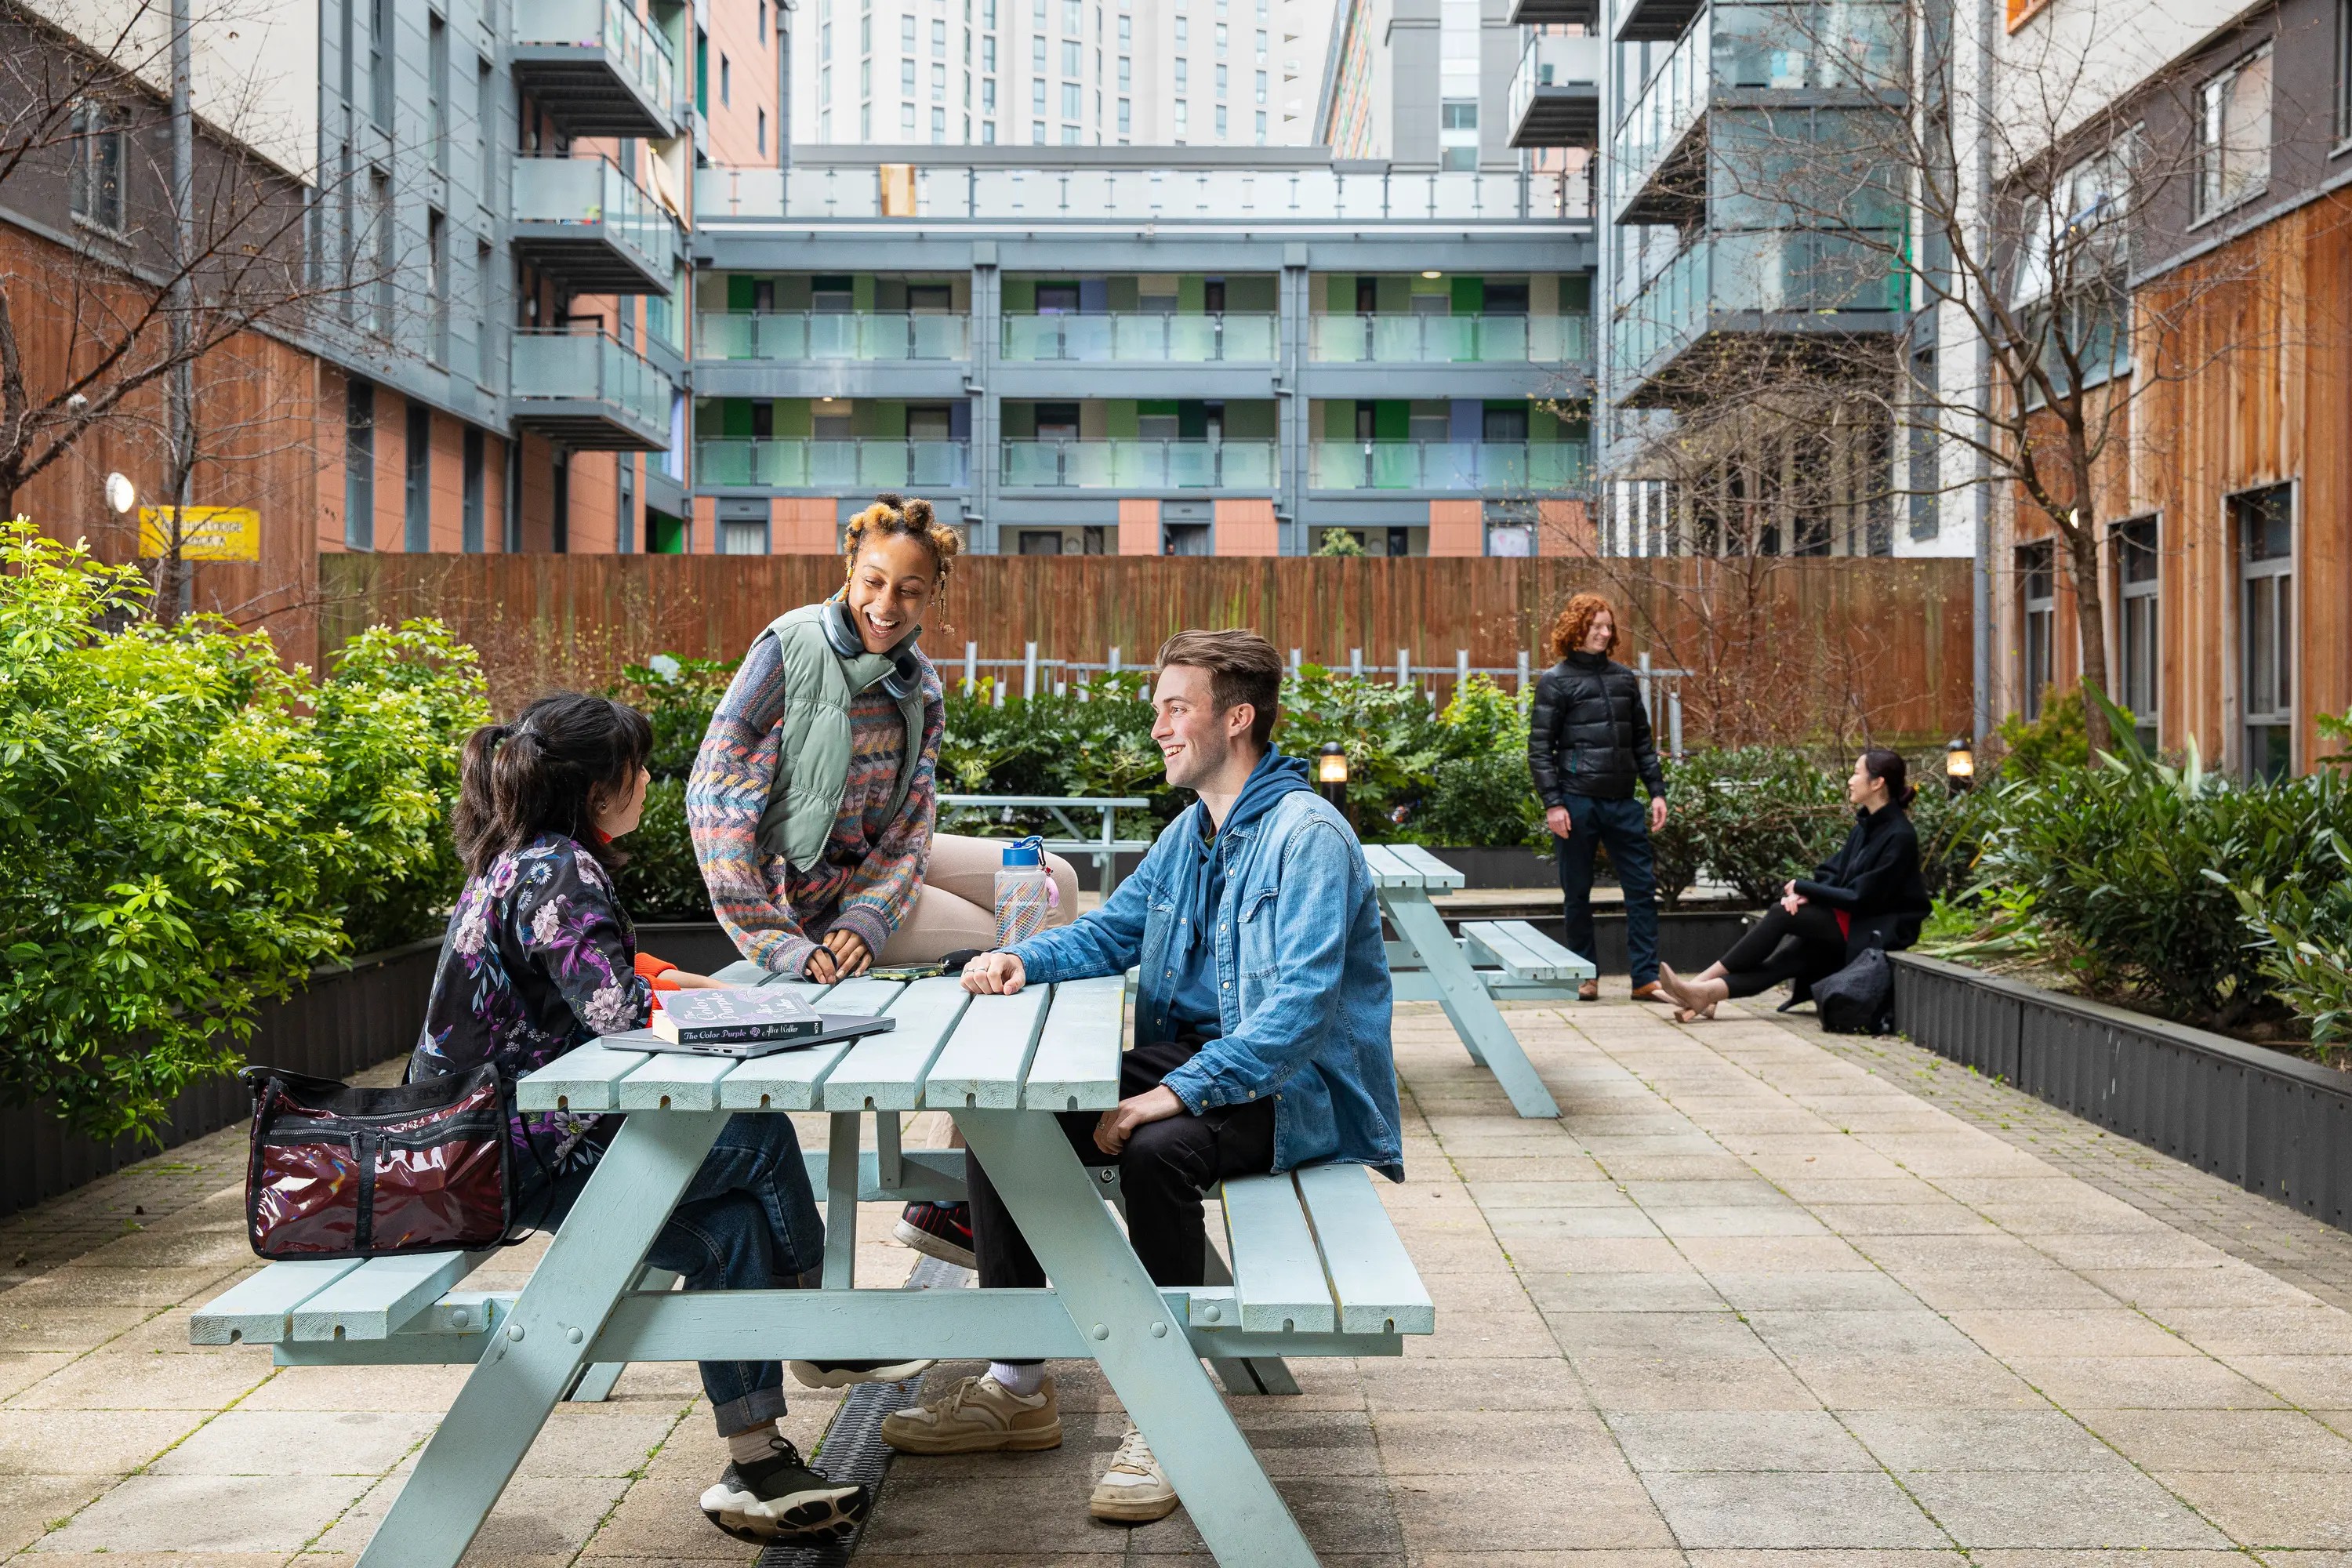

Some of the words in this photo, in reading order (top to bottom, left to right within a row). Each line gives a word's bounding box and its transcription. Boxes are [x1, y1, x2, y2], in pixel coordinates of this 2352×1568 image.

[684, 1010, 697, 1019] The
[691, 997, 717, 1020] Color
[706, 992, 739, 1020] Purple
[699, 1030, 720, 1039] Color
[721, 1029, 746, 1038] Purple
[762, 1025, 779, 1036] Alice
[780, 1024, 798, 1033] Walker
